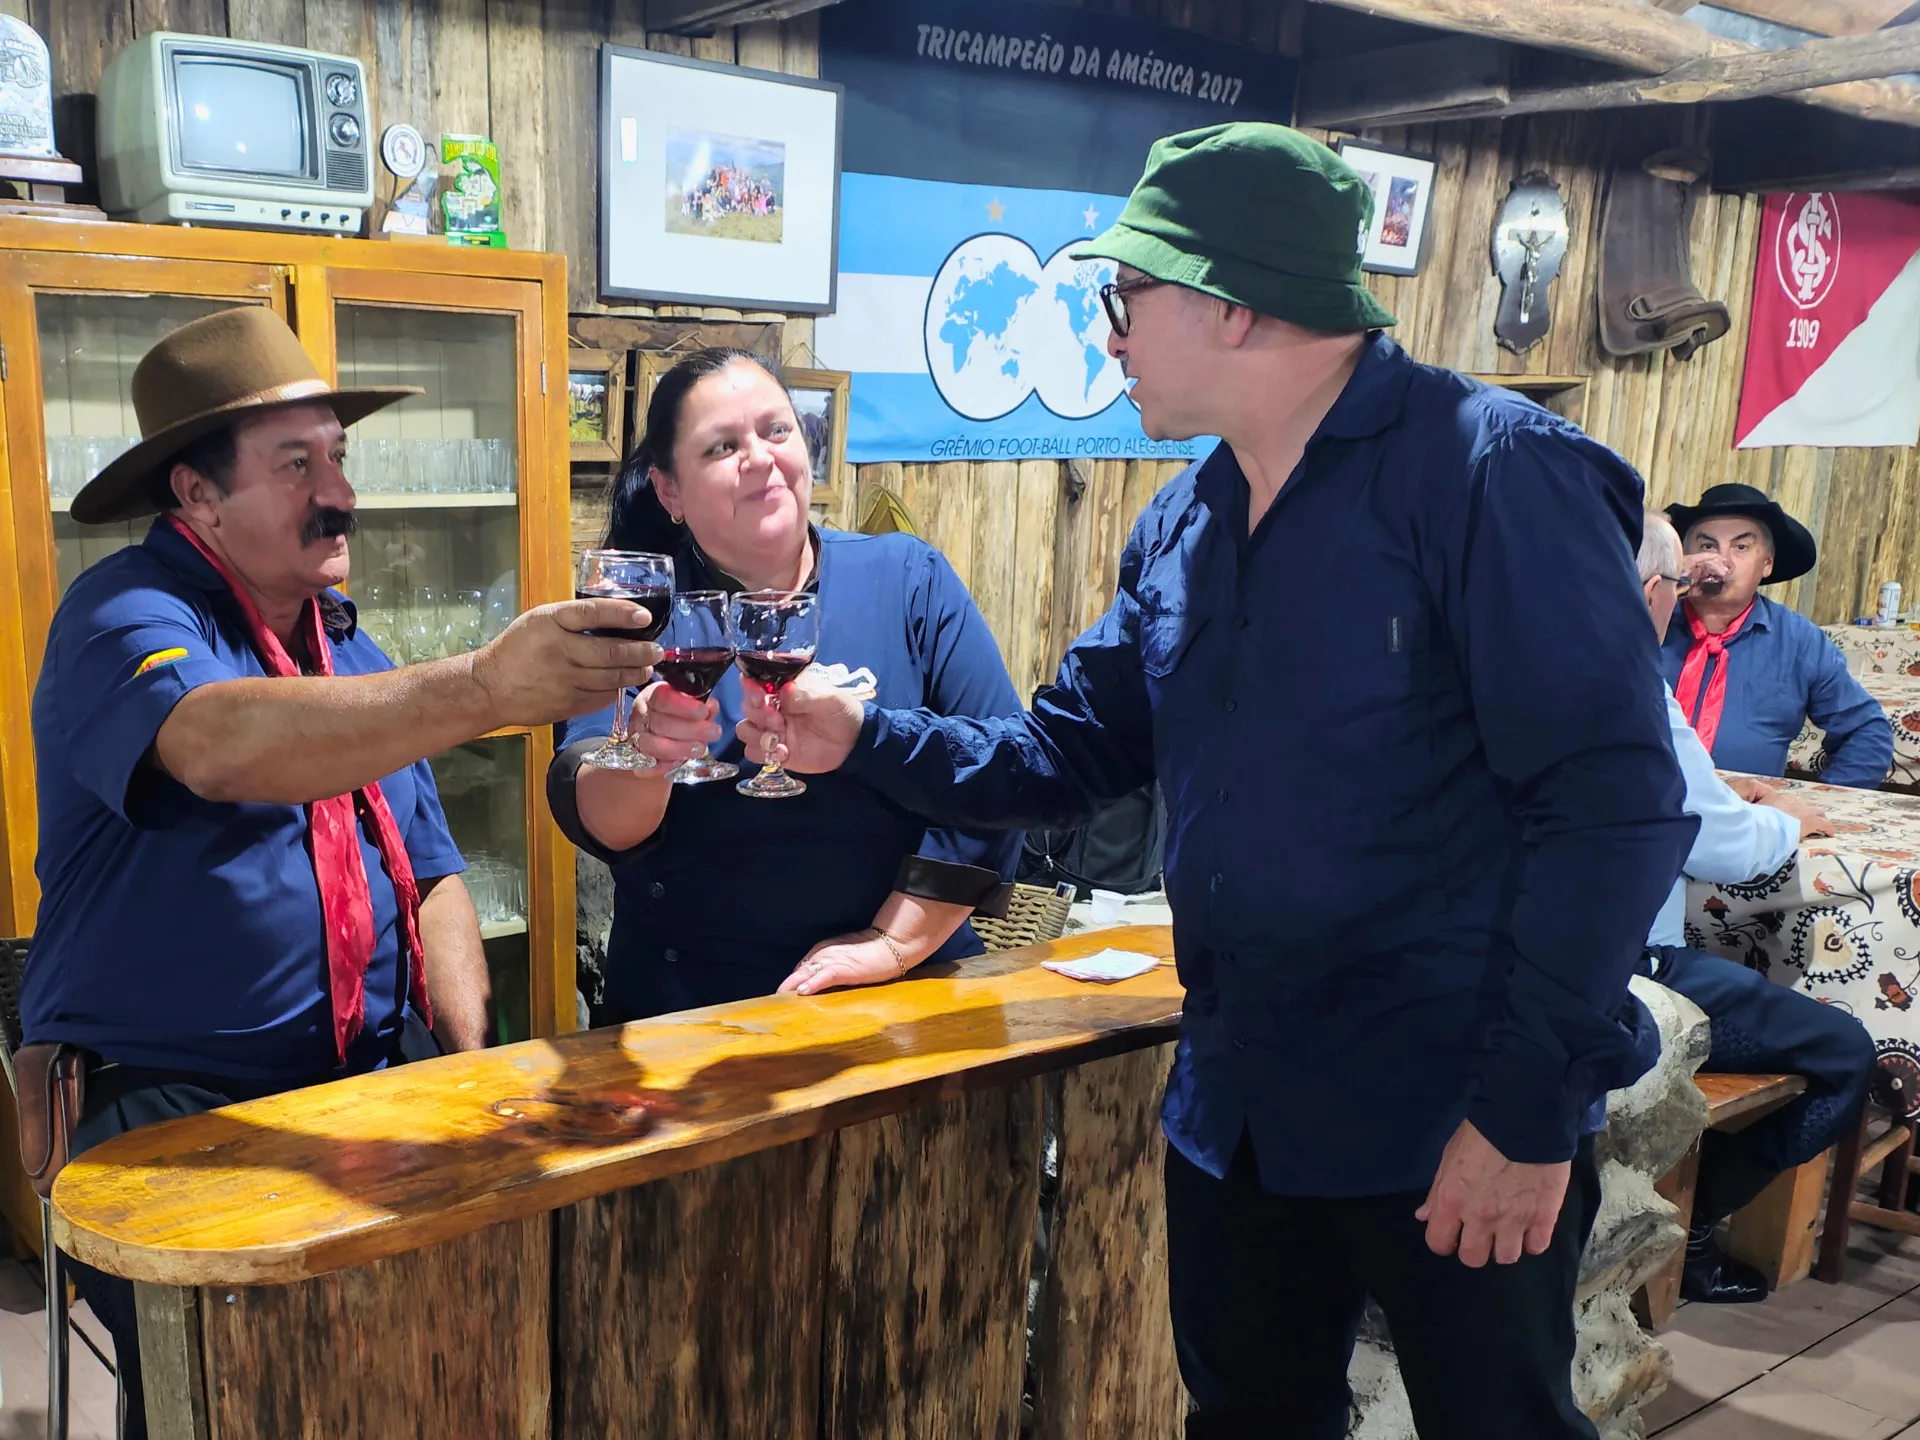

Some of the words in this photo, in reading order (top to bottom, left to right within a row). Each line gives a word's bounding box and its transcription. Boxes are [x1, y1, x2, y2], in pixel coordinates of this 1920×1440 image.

[917, 24, 1064, 74] TRICAMPEÃO
[1070, 45, 1099, 78] DA
[1106, 50, 1194, 97] AMÉRICA
[1198, 70, 1243, 106] 2017
[1786, 317, 1820, 349] 1909
[930, 434, 994, 457] GRÊMIO
[998, 437, 1071, 456] FOOT-BALL
[1076, 437, 1121, 456] PORTO
[1124, 437, 1196, 456] ALEGRENSE
